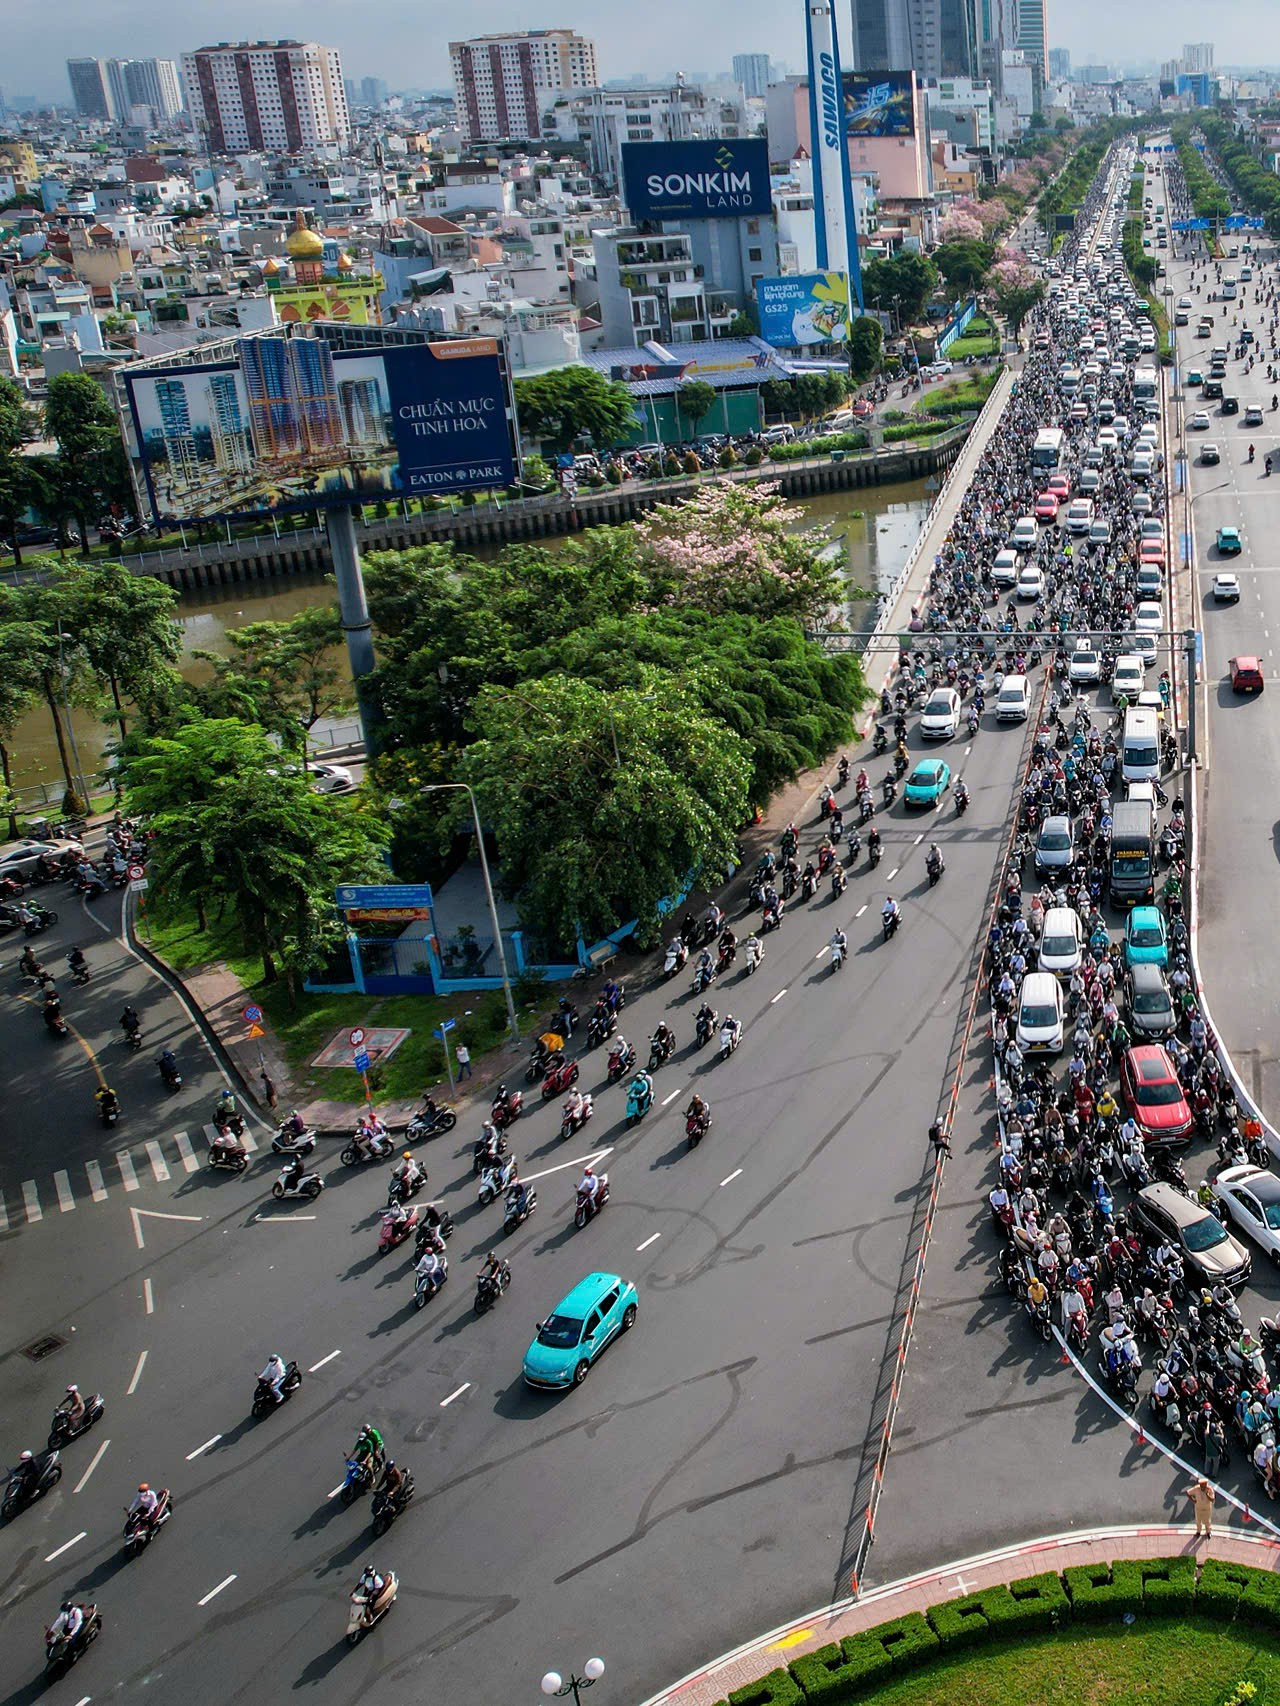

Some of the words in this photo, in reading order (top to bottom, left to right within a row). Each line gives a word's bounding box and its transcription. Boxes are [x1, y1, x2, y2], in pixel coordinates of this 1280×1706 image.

[820, 52, 839, 151] SAWACO
[647, 171, 751, 196] SONKIM
[706, 194, 752, 208] LAND
[765, 304, 788, 313] GS25
[399, 398, 453, 419] CHUẨN
[458, 397, 495, 415] MỰC
[411, 420, 449, 436] TINH
[453, 417, 488, 432] HOA
[410, 471, 453, 485] EATON
[469, 466, 503, 479] PARK
